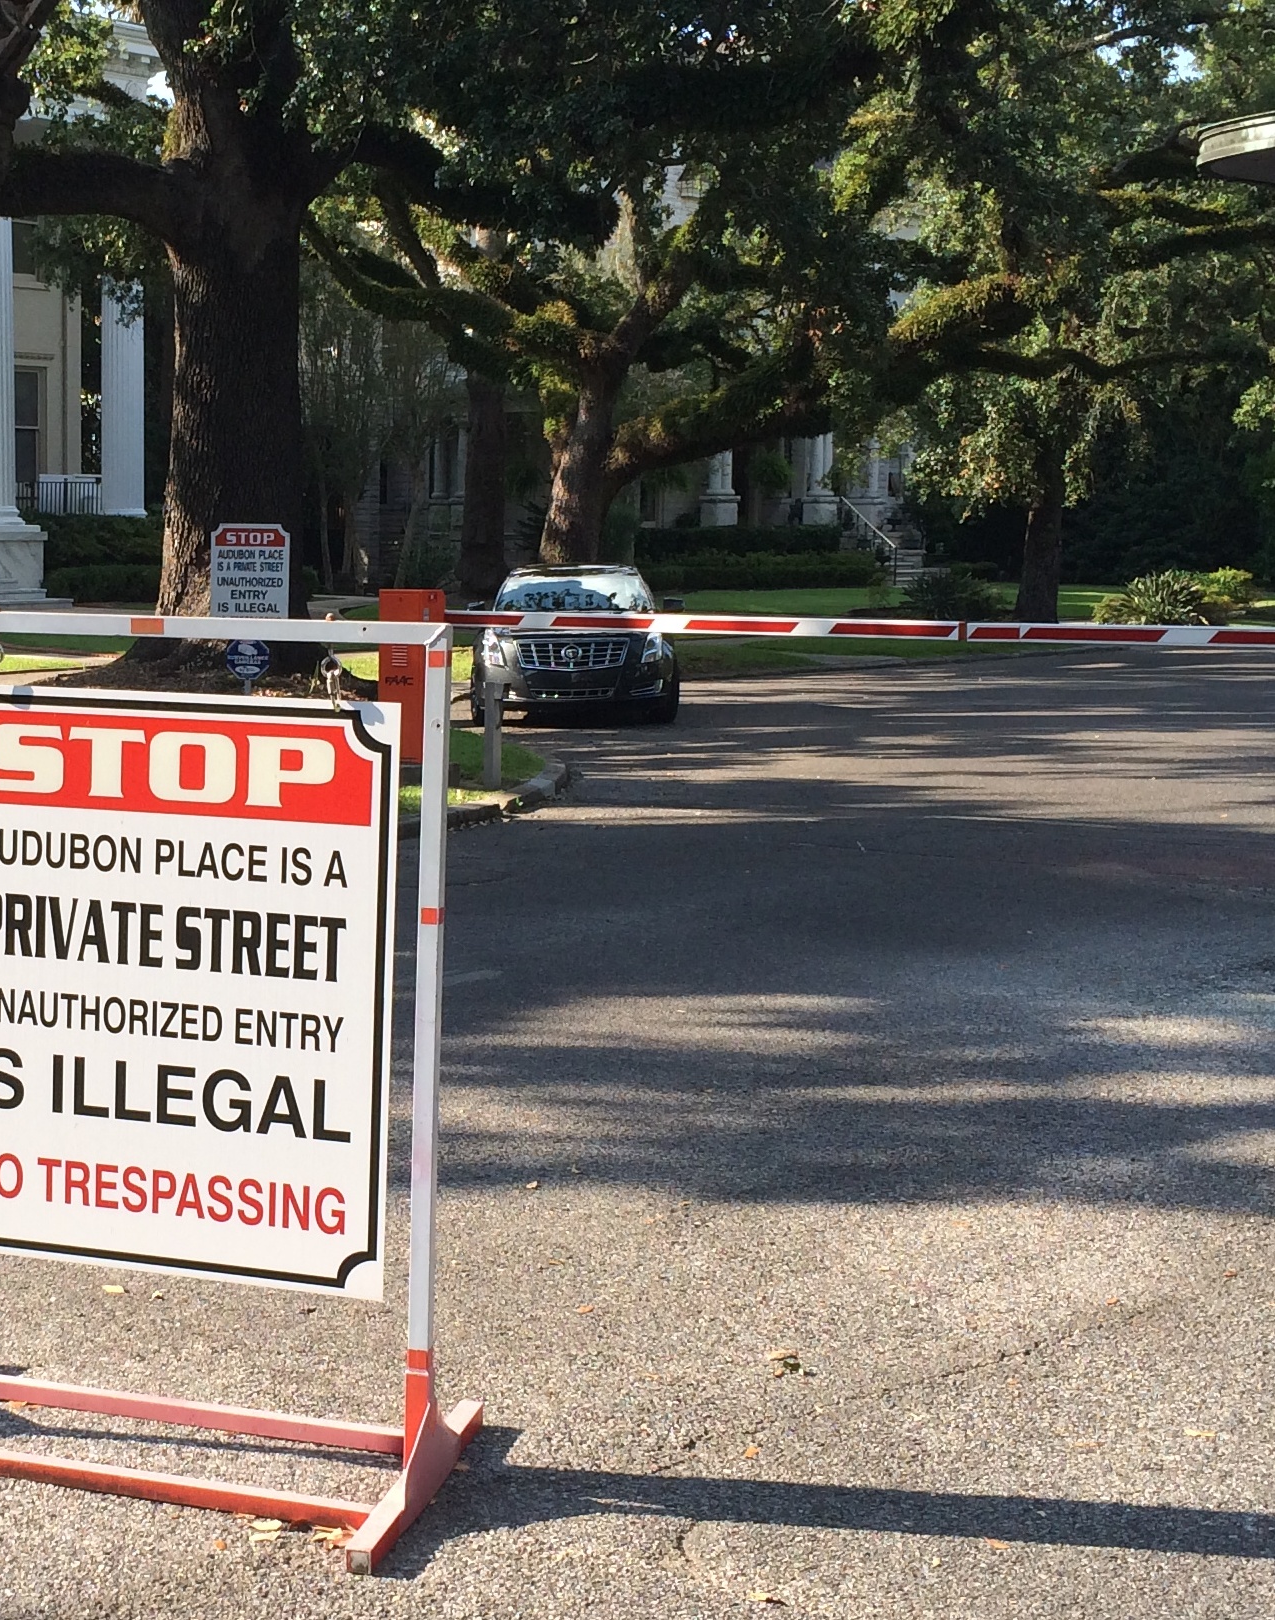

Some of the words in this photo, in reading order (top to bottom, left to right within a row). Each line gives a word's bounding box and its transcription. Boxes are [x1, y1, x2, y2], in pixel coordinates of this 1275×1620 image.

[226, 532, 274, 544] STOP
[218, 549, 255, 560] AUDUBON
[259, 550, 283, 560] PLACE
[217, 562, 223, 571] IS
[226, 562, 231, 571] A
[233, 562, 257, 572] PRIVATE
[260, 562, 283, 572] STREET
[217, 576, 283, 587] UNAUTHORIZED
[230, 589, 268, 600] ENTRY
[218, 602, 229, 613] IS
[235, 602, 280, 613] ILLEGAL
[155, 838, 268, 883] PLACE
[281, 846, 312, 886] IS
[323, 850, 348, 889] A
[175, 906, 347, 983] STREET
[234, 1008, 344, 1053] ENTRY
[52, 1054, 352, 1144] ILLEGAL
[36, 1157, 346, 1235] TRESPASSING
